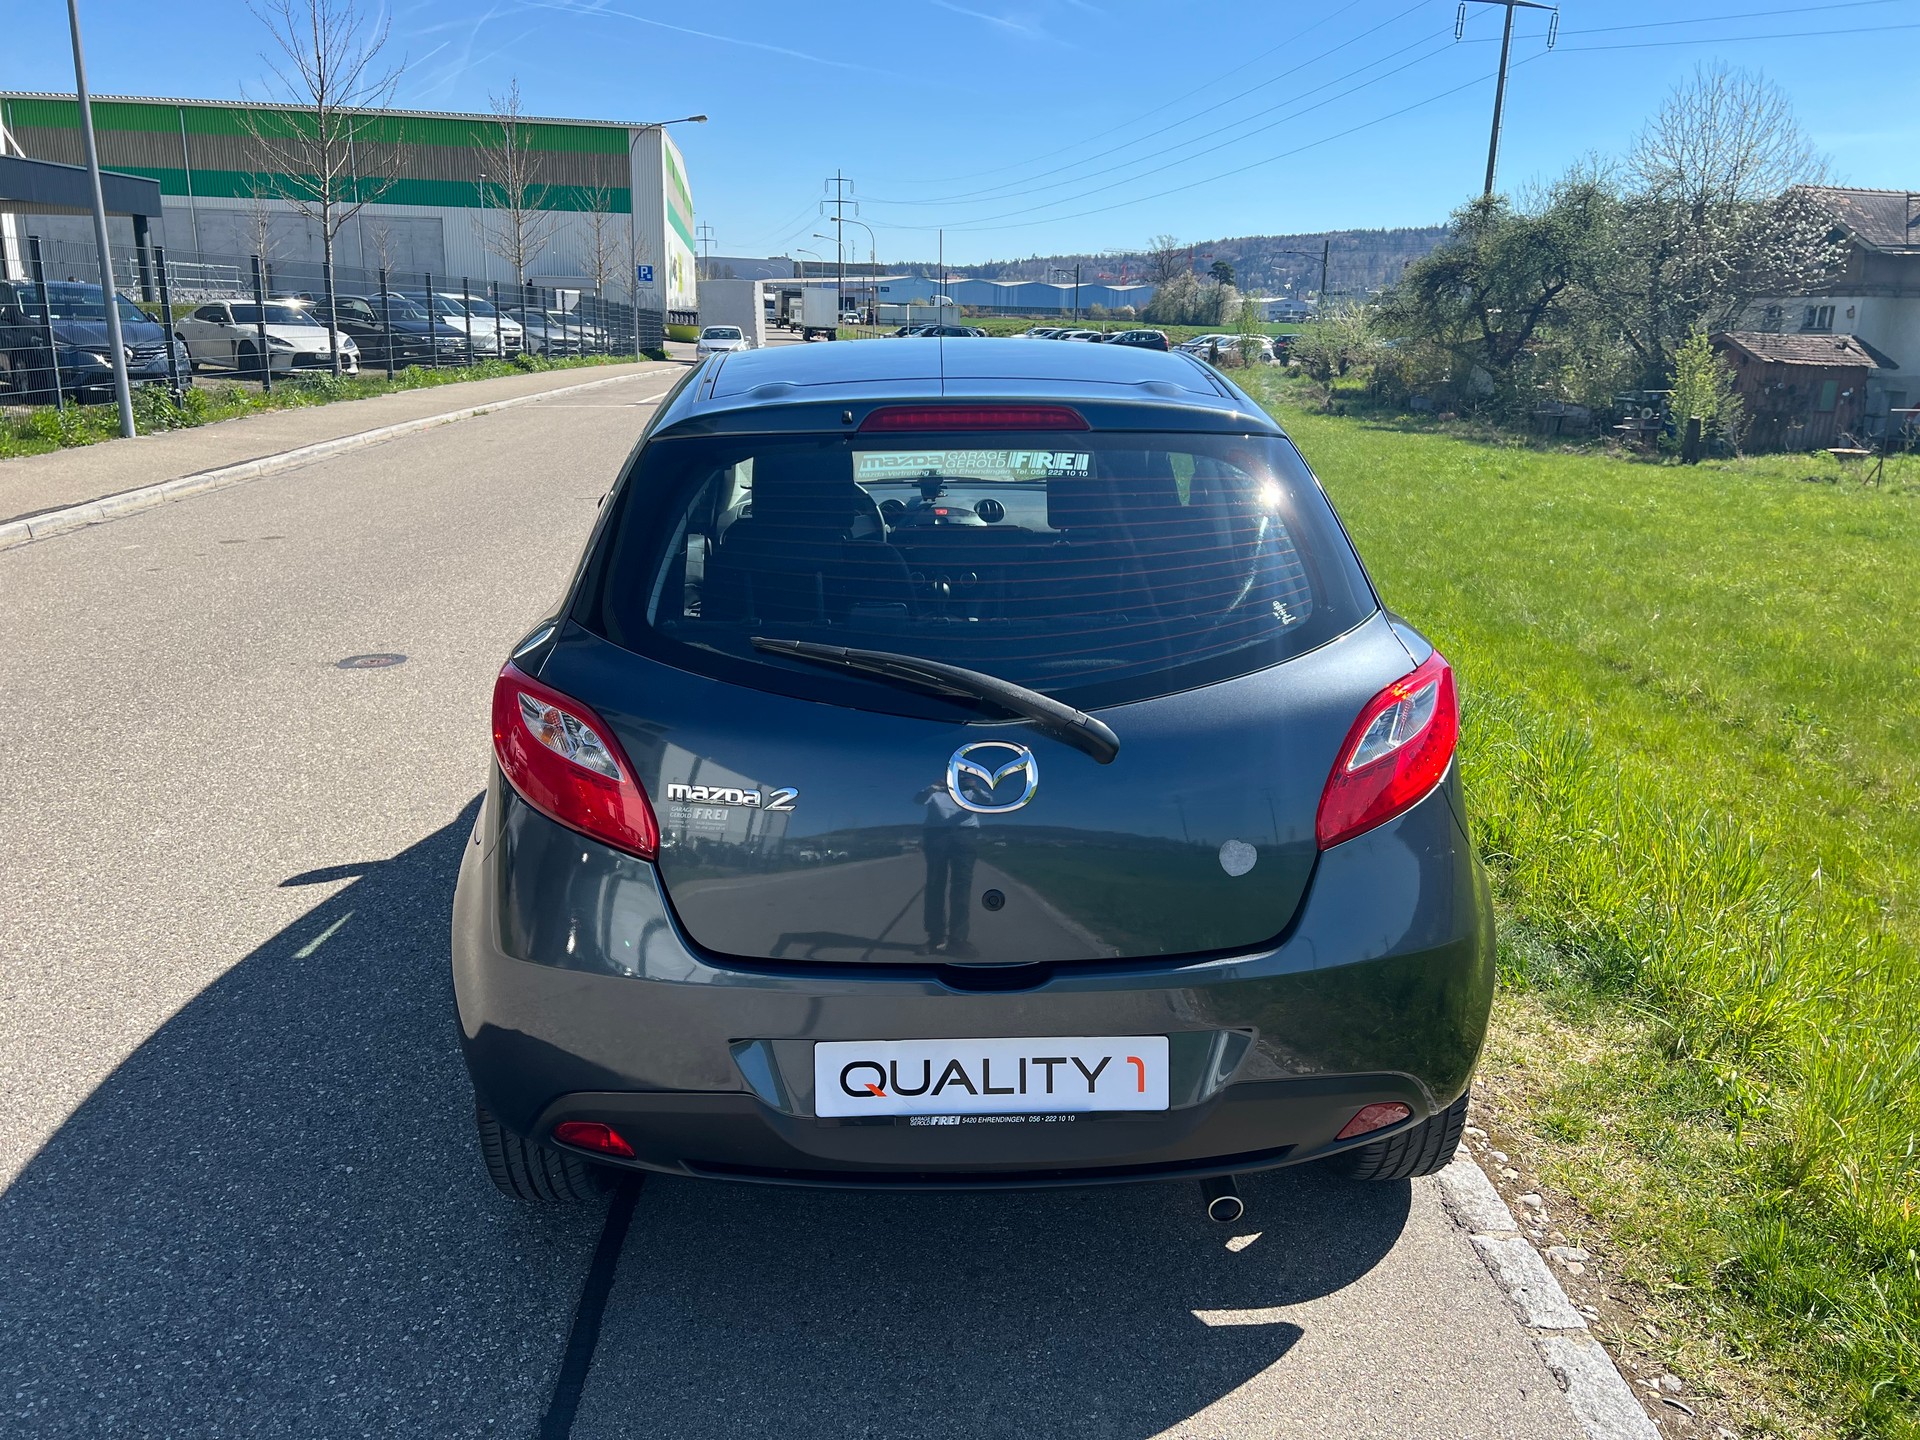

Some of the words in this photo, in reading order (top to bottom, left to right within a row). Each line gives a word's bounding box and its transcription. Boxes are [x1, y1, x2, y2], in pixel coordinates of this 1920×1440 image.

[640, 266, 649, 278] P
[947, 451, 1008, 460] GARAGE
[945, 460, 1006, 468] GEROLD
[763, 786, 799, 811] 2
[693, 808, 729, 821] FREI
[839, 1055, 1113, 1098] QUALITY
[1126, 1056, 1145, 1093] 1
[930, 1115, 961, 1126] FREI
[961, 1116, 977, 1124] 5420
[977, 1115, 1026, 1124] EHRENDINGEN
[1028, 1115, 1041, 1123] 056
[1067, 1114, 1076, 1122] 10
